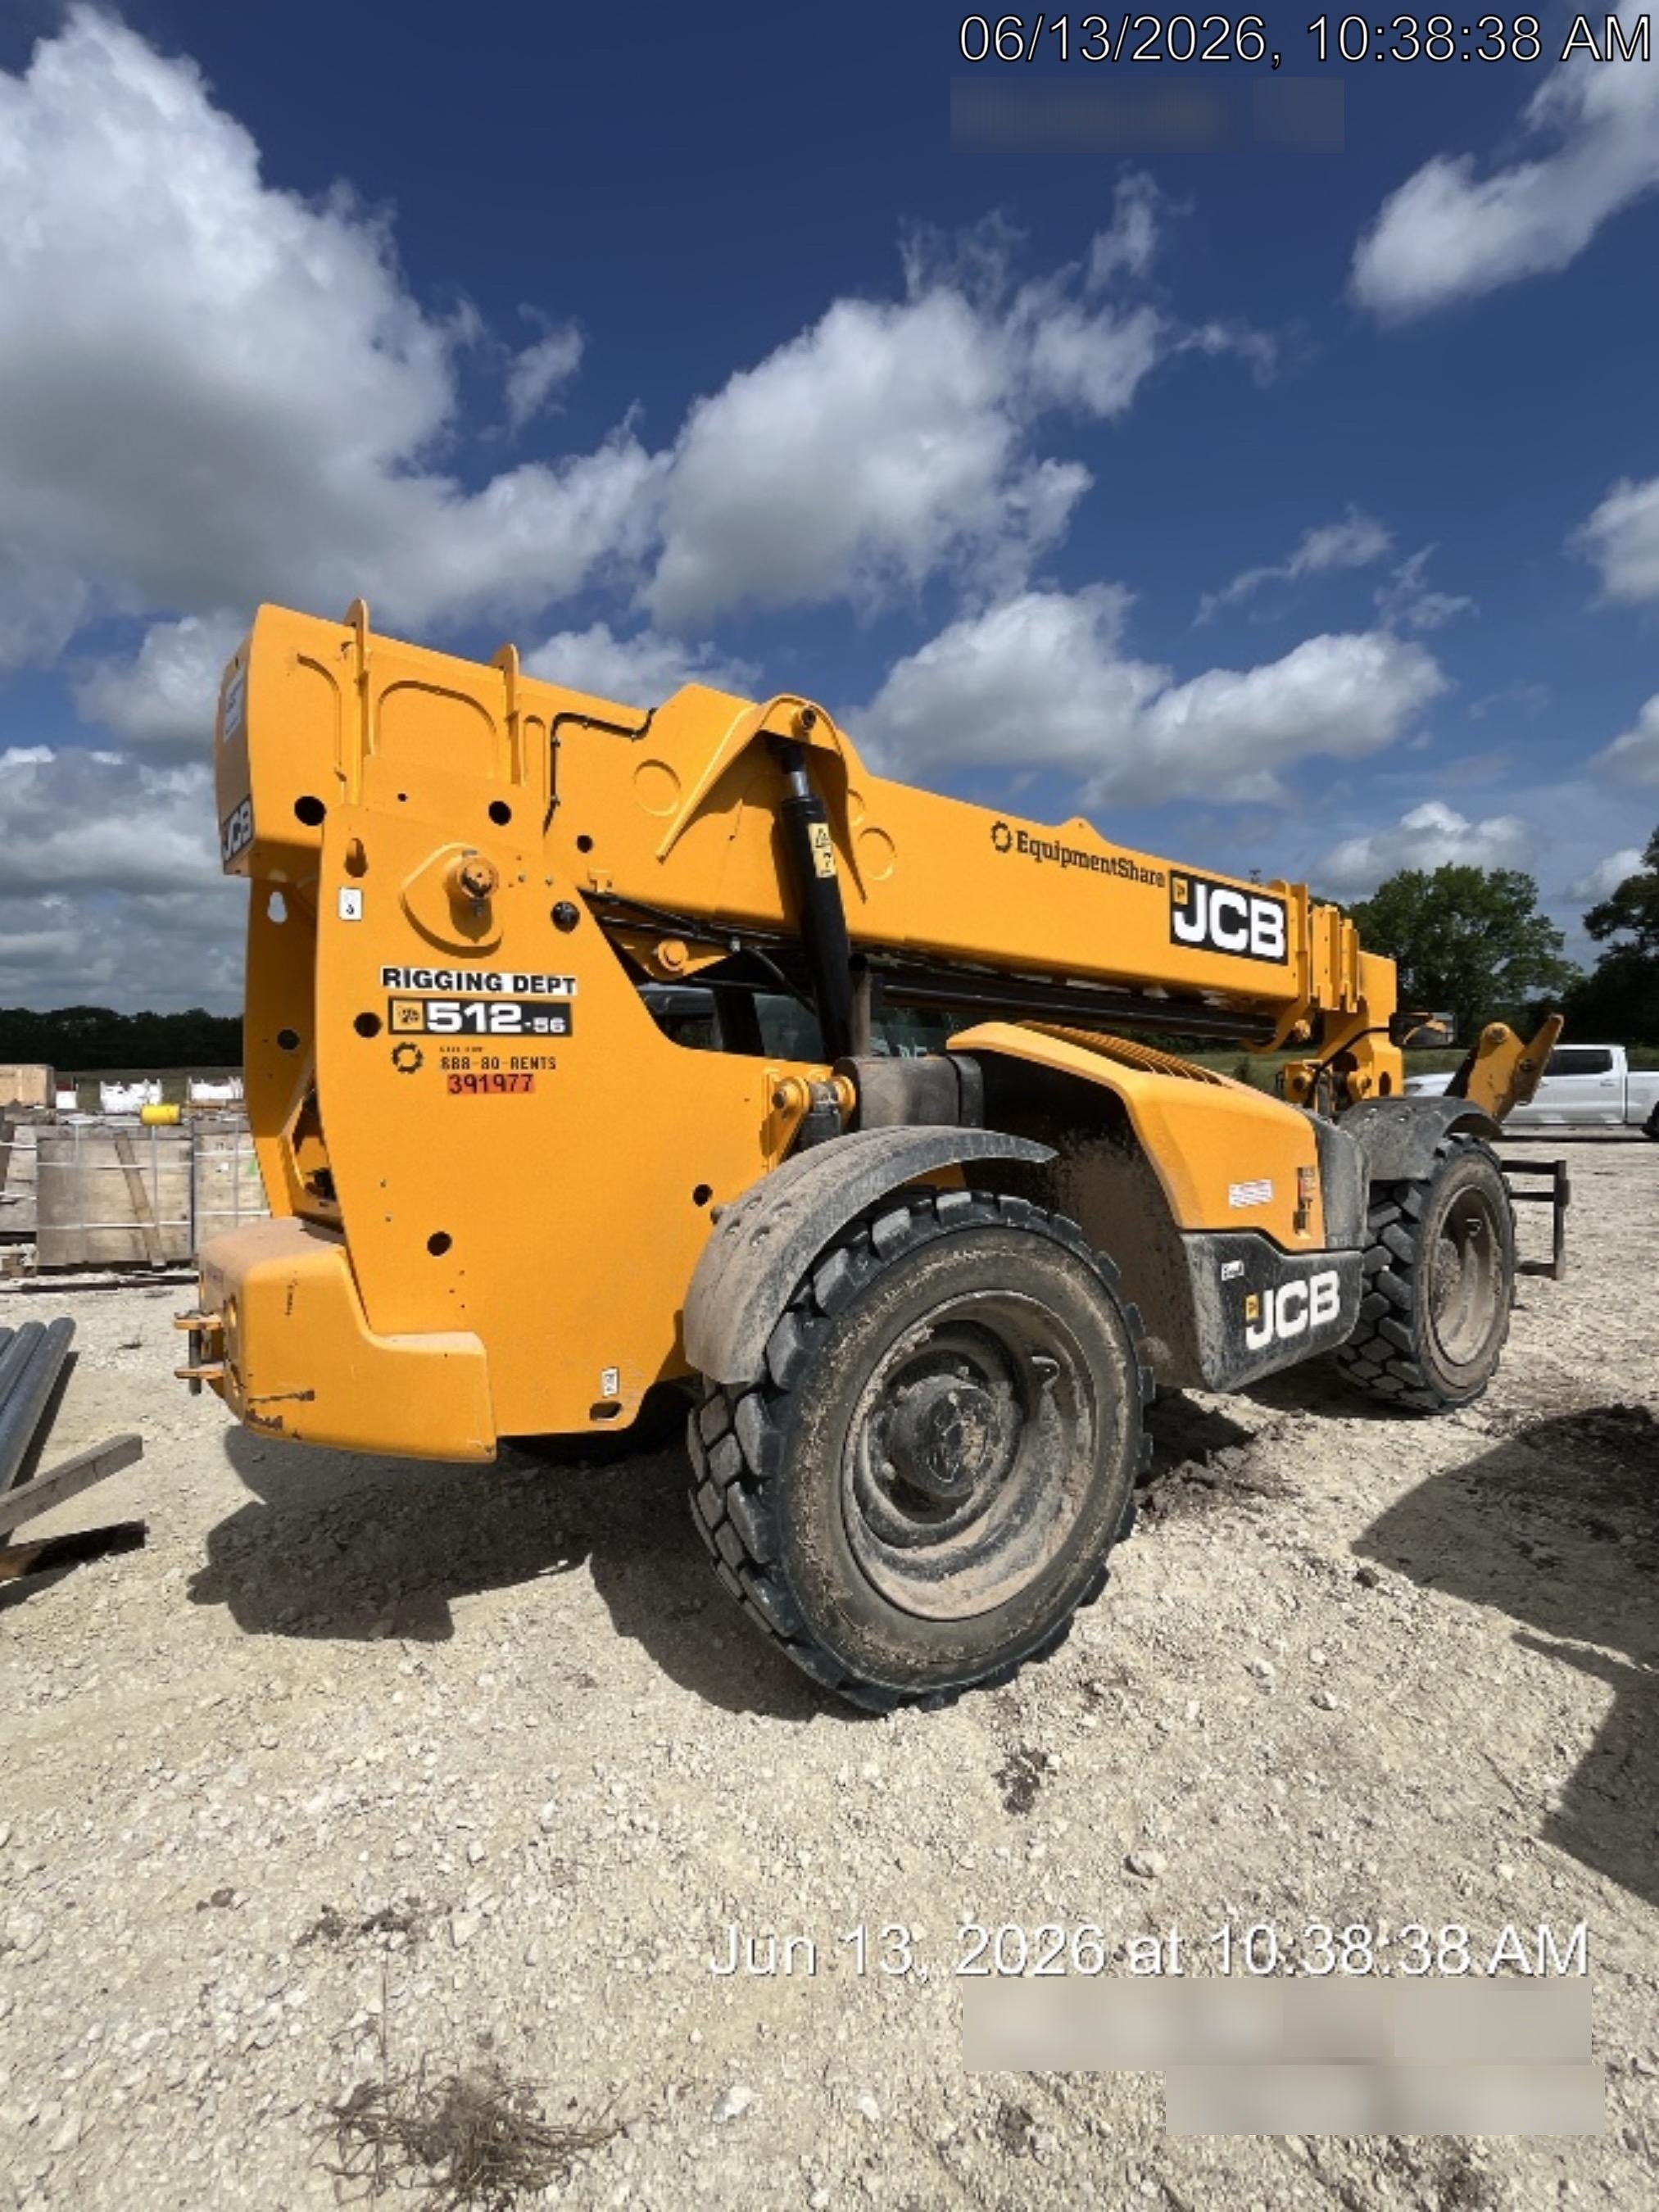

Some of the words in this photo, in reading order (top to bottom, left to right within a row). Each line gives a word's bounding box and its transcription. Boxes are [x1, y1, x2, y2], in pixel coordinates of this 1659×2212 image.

[1016, 829, 1166, 887] EquipmentShare
[1173, 883, 1285, 959] JCB
[383, 968, 502, 991] RIGGING
[513, 975, 576, 994] DEPT
[448, 1073, 533, 1095] 391977
[1246, 1271, 1339, 1350] JCB
